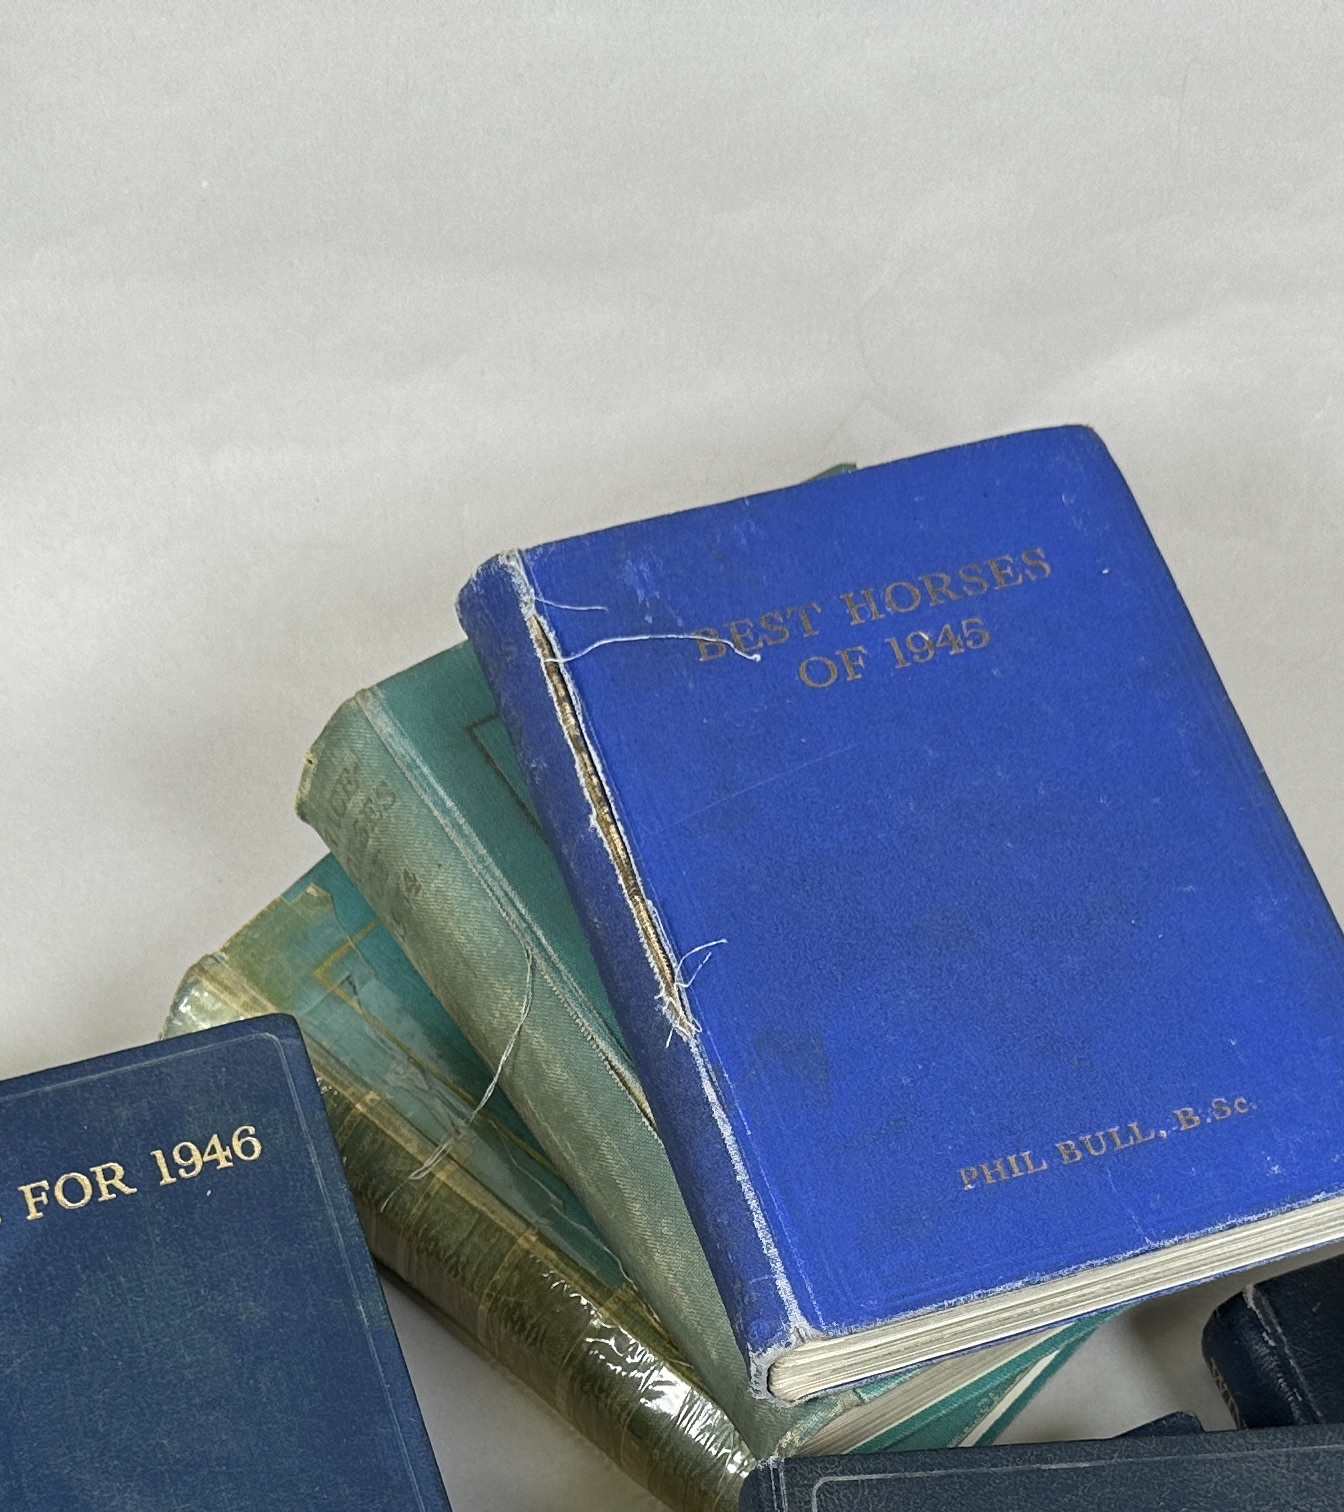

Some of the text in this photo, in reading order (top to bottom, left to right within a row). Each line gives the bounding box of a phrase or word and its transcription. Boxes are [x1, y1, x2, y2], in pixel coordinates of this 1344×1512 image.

[690, 547, 1052, 662] BEST HORSES
[799, 617, 991, 689] OF 1945
[17, 1161, 138, 1222] FOR
[150, 1124, 264, 1187] 1946
[959, 1150, 1048, 1191] PHIL
